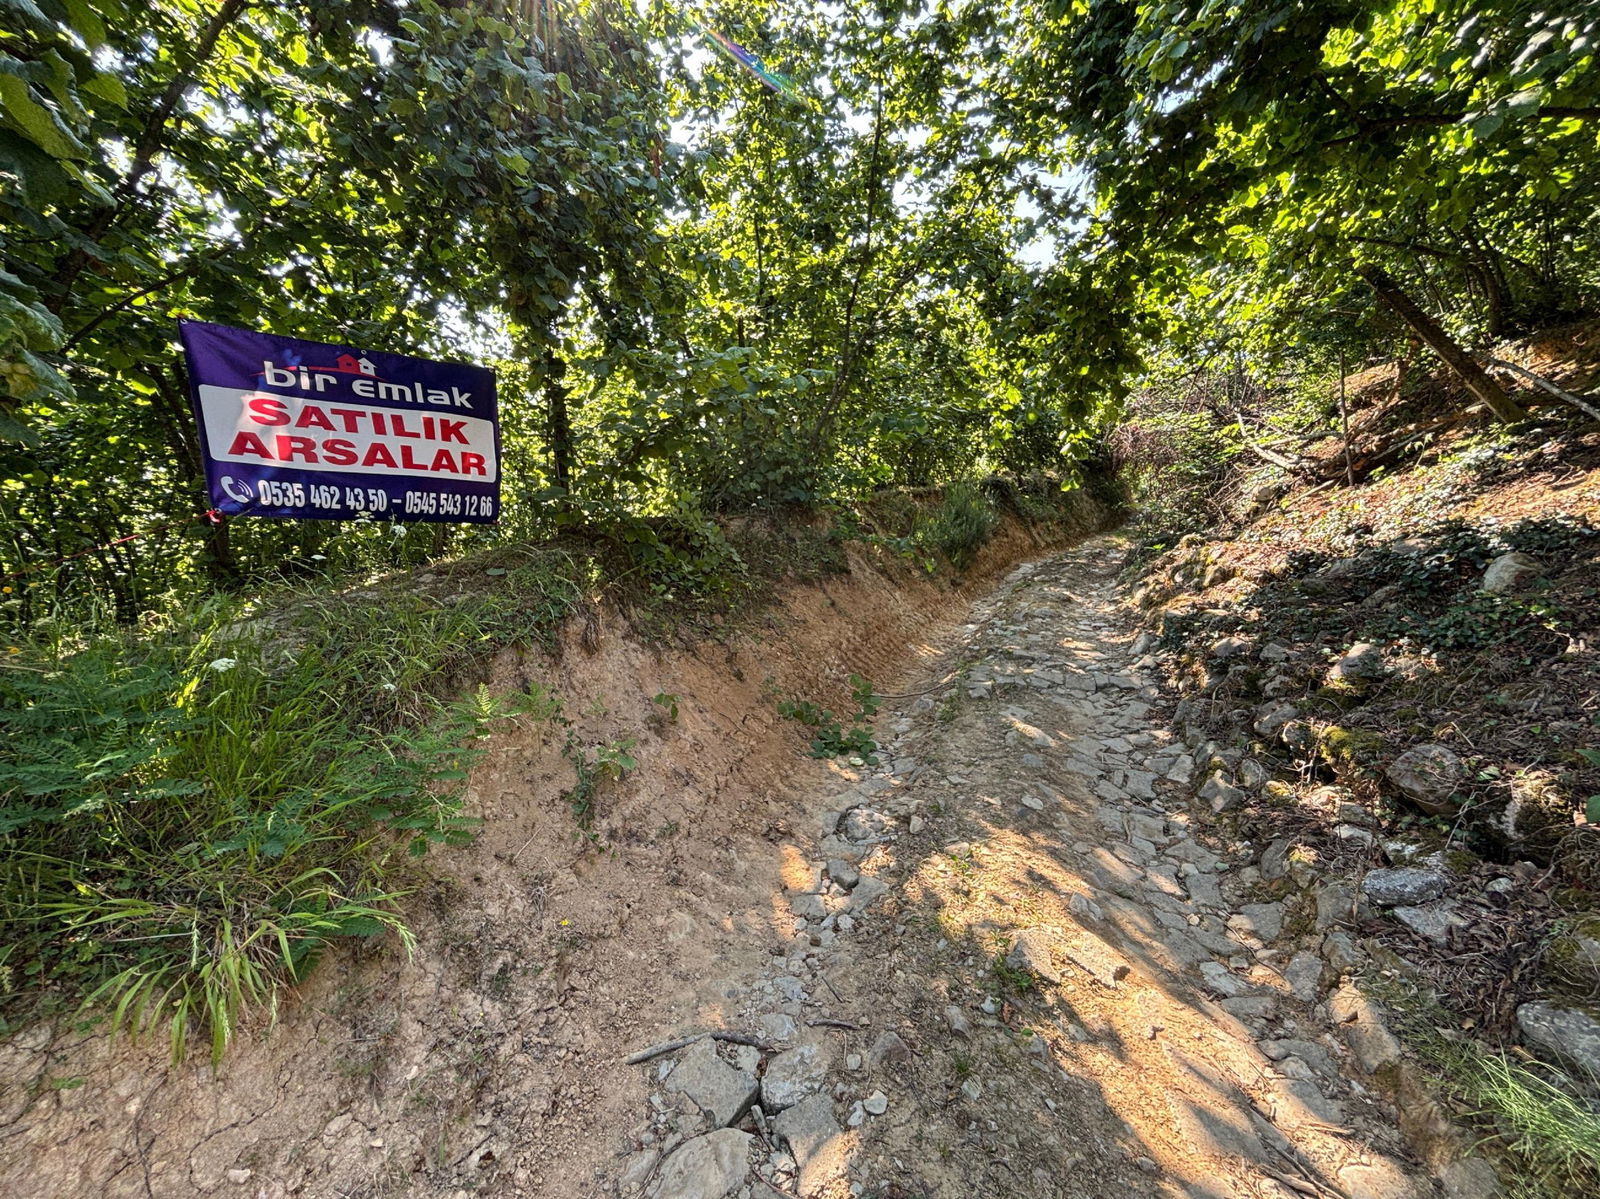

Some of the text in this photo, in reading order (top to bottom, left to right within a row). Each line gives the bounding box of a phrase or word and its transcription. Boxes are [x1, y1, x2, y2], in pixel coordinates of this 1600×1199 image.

[263, 361, 474, 409] bir emlak
[249, 399, 470, 445] SATILIK
[228, 431, 487, 476] ARSALAR
[258, 480, 305, 507] 0535
[310, 484, 341, 509] 462
[345, 487, 365, 510] 43
[368, 488, 387, 512] 50
[405, 491, 436, 515] 0545
[439, 493, 461, 515] 543
[465, 495, 477, 516] 12
[480, 496, 492, 517] 66
